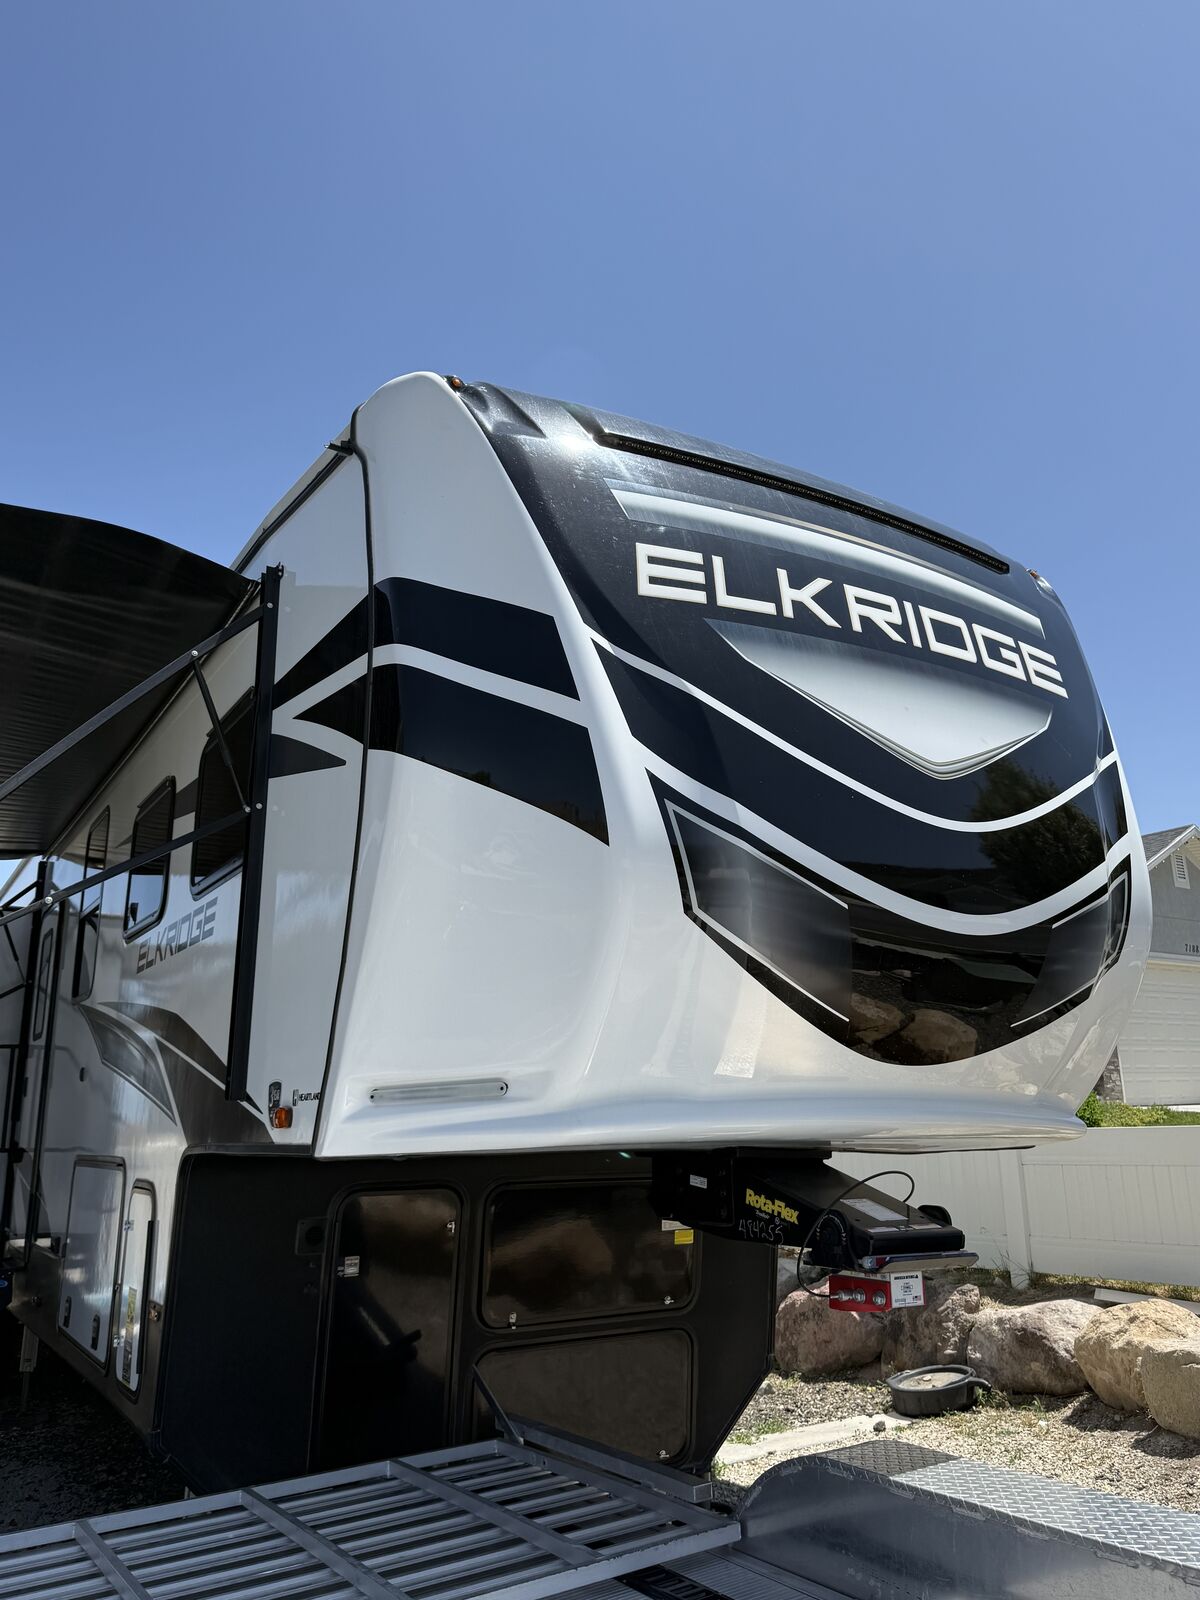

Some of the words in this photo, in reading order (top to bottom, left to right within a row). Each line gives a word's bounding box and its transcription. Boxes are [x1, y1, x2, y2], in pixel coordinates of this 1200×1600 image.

[635, 542, 1069, 699] ELKRIDGE
[136, 897, 218, 974] ELKRIDGE
[744, 1187, 800, 1225] Rota-Flex
